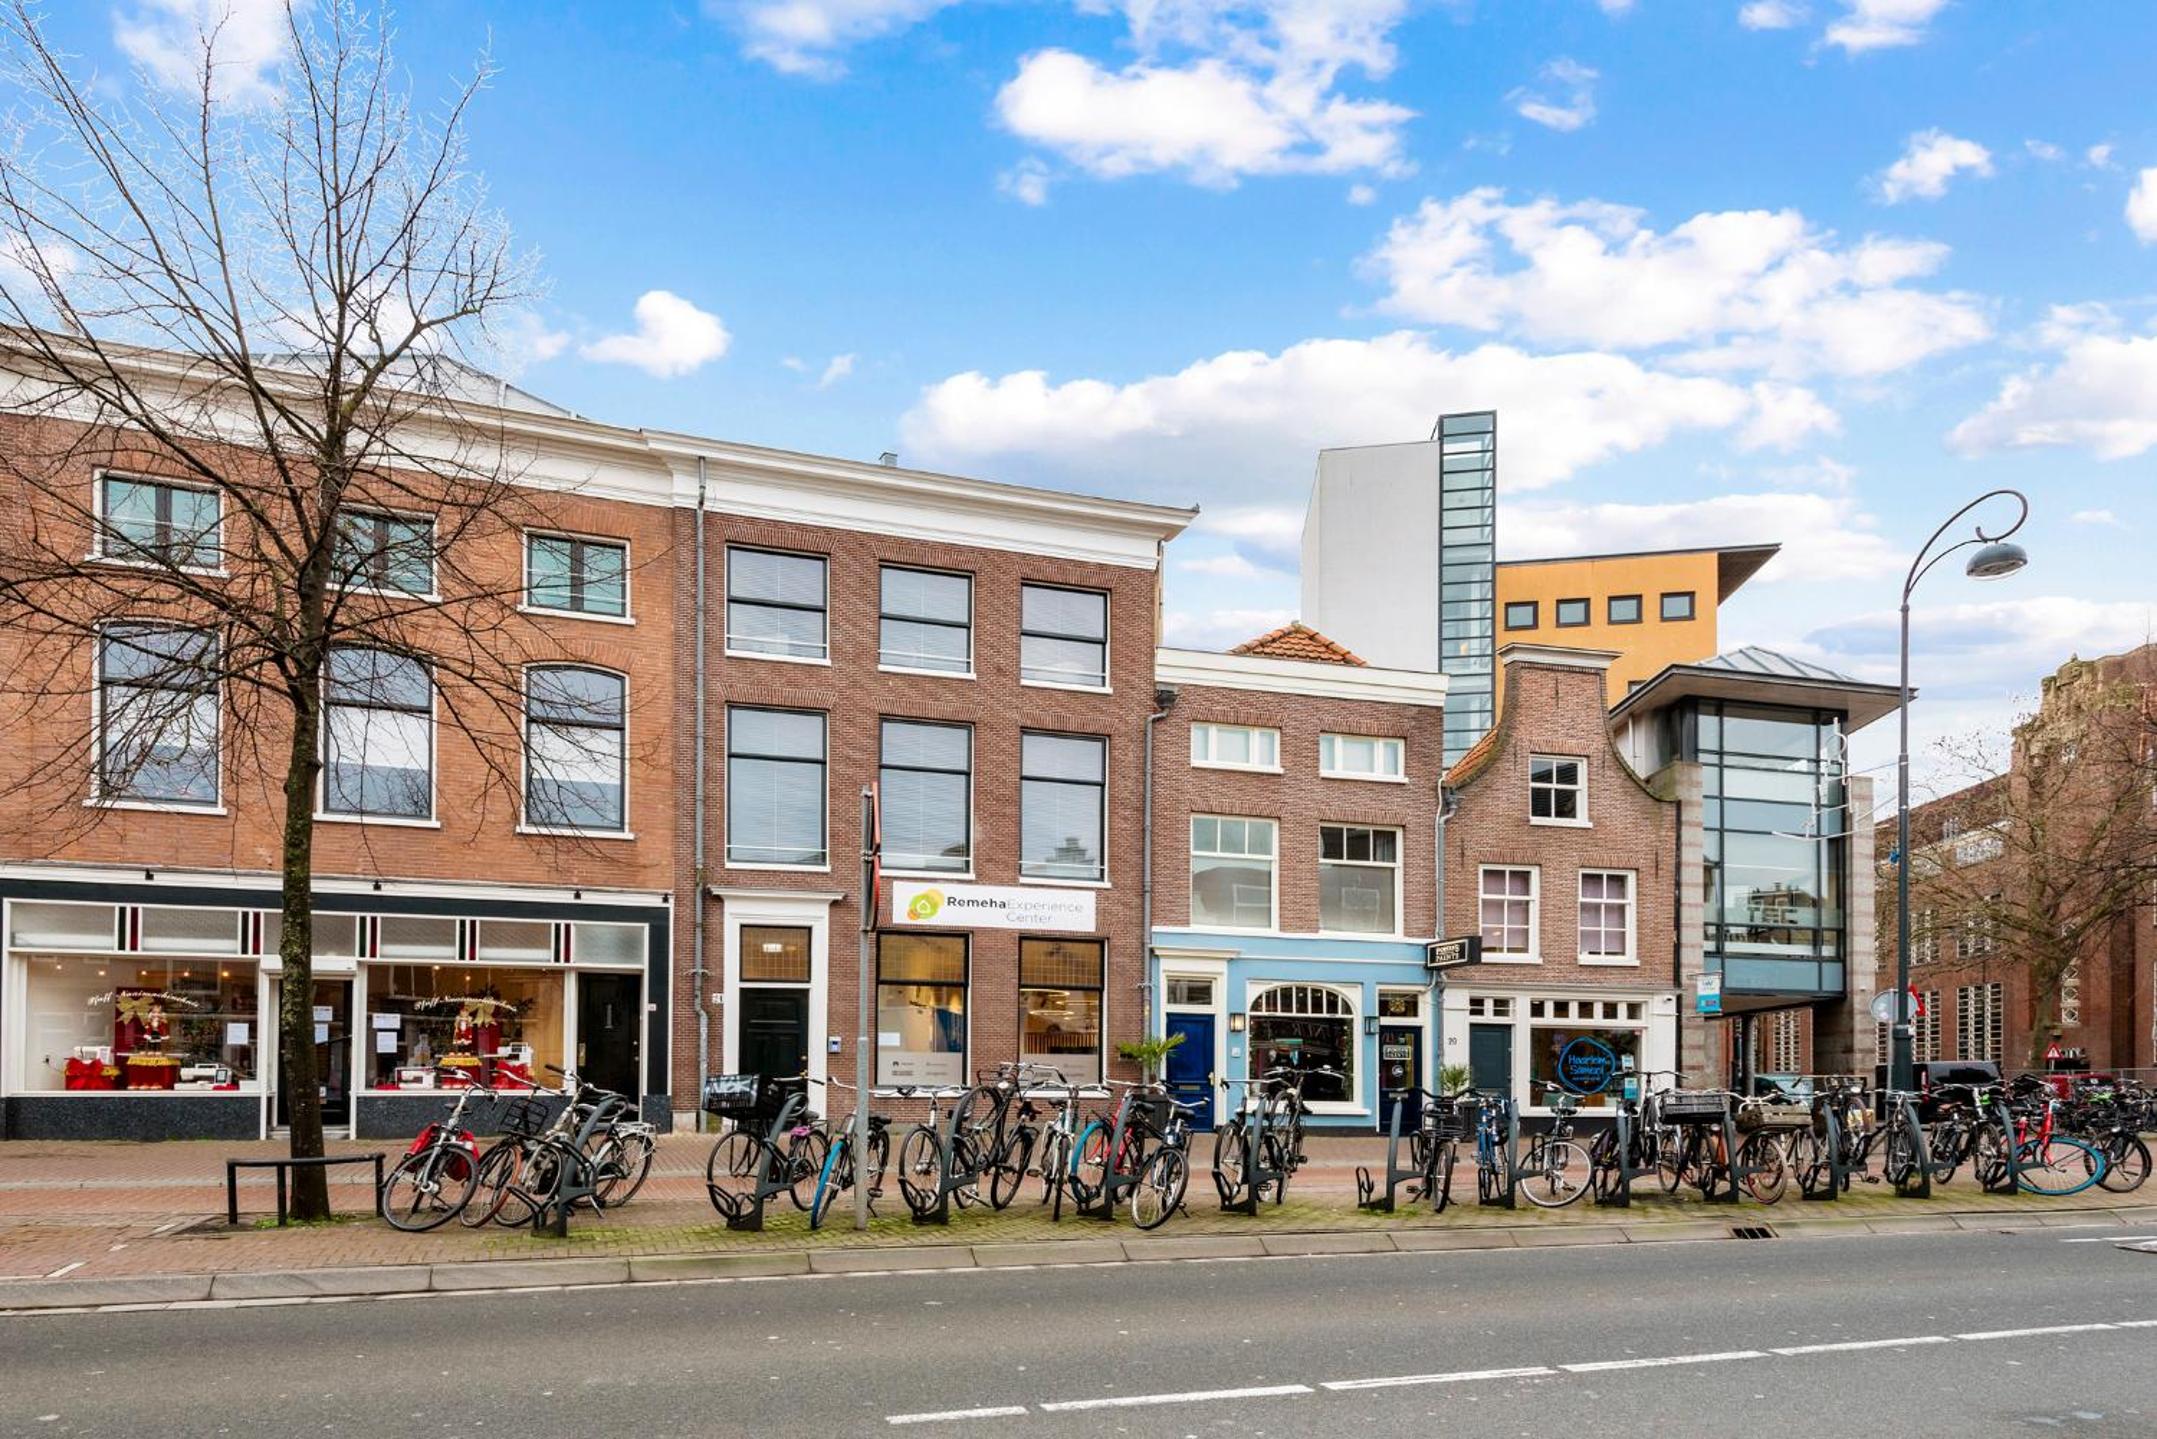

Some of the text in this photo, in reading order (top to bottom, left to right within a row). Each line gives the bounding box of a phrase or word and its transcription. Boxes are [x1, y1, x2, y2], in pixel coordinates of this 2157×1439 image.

[946, 896, 1083, 914] Remeha Experience
[1007, 911, 1052, 924] Center
